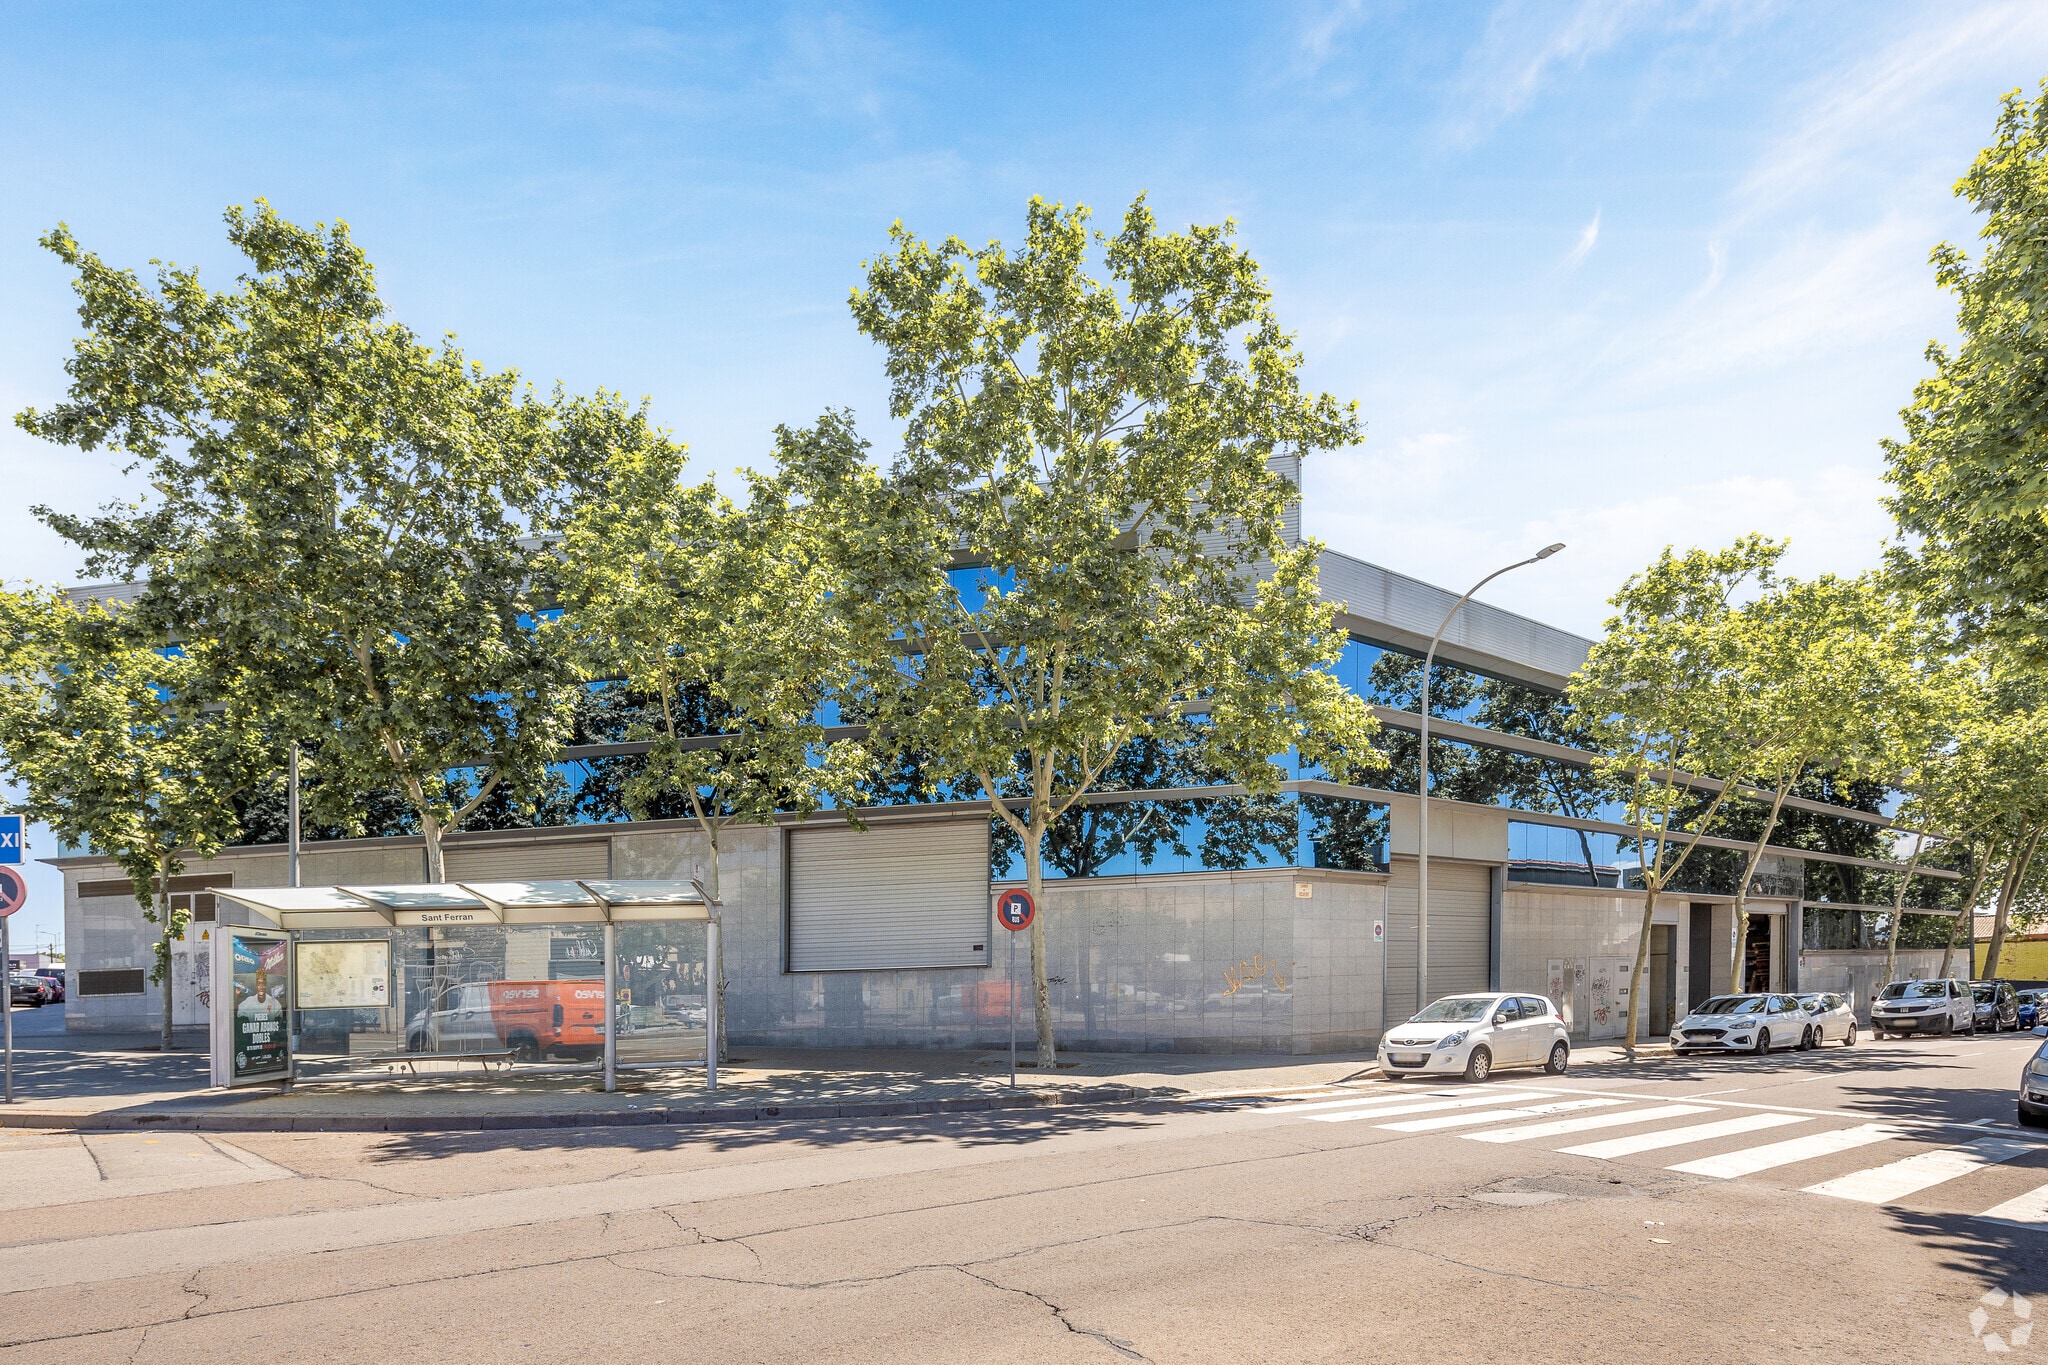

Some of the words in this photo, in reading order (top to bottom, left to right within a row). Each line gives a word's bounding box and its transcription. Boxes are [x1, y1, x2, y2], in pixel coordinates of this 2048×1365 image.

[421, 914, 442, 922] Sant
[444, 913, 474, 921] Ferran
[242, 1022, 260, 1034] GANAR
[252, 1032, 271, 1044] DOBLES
